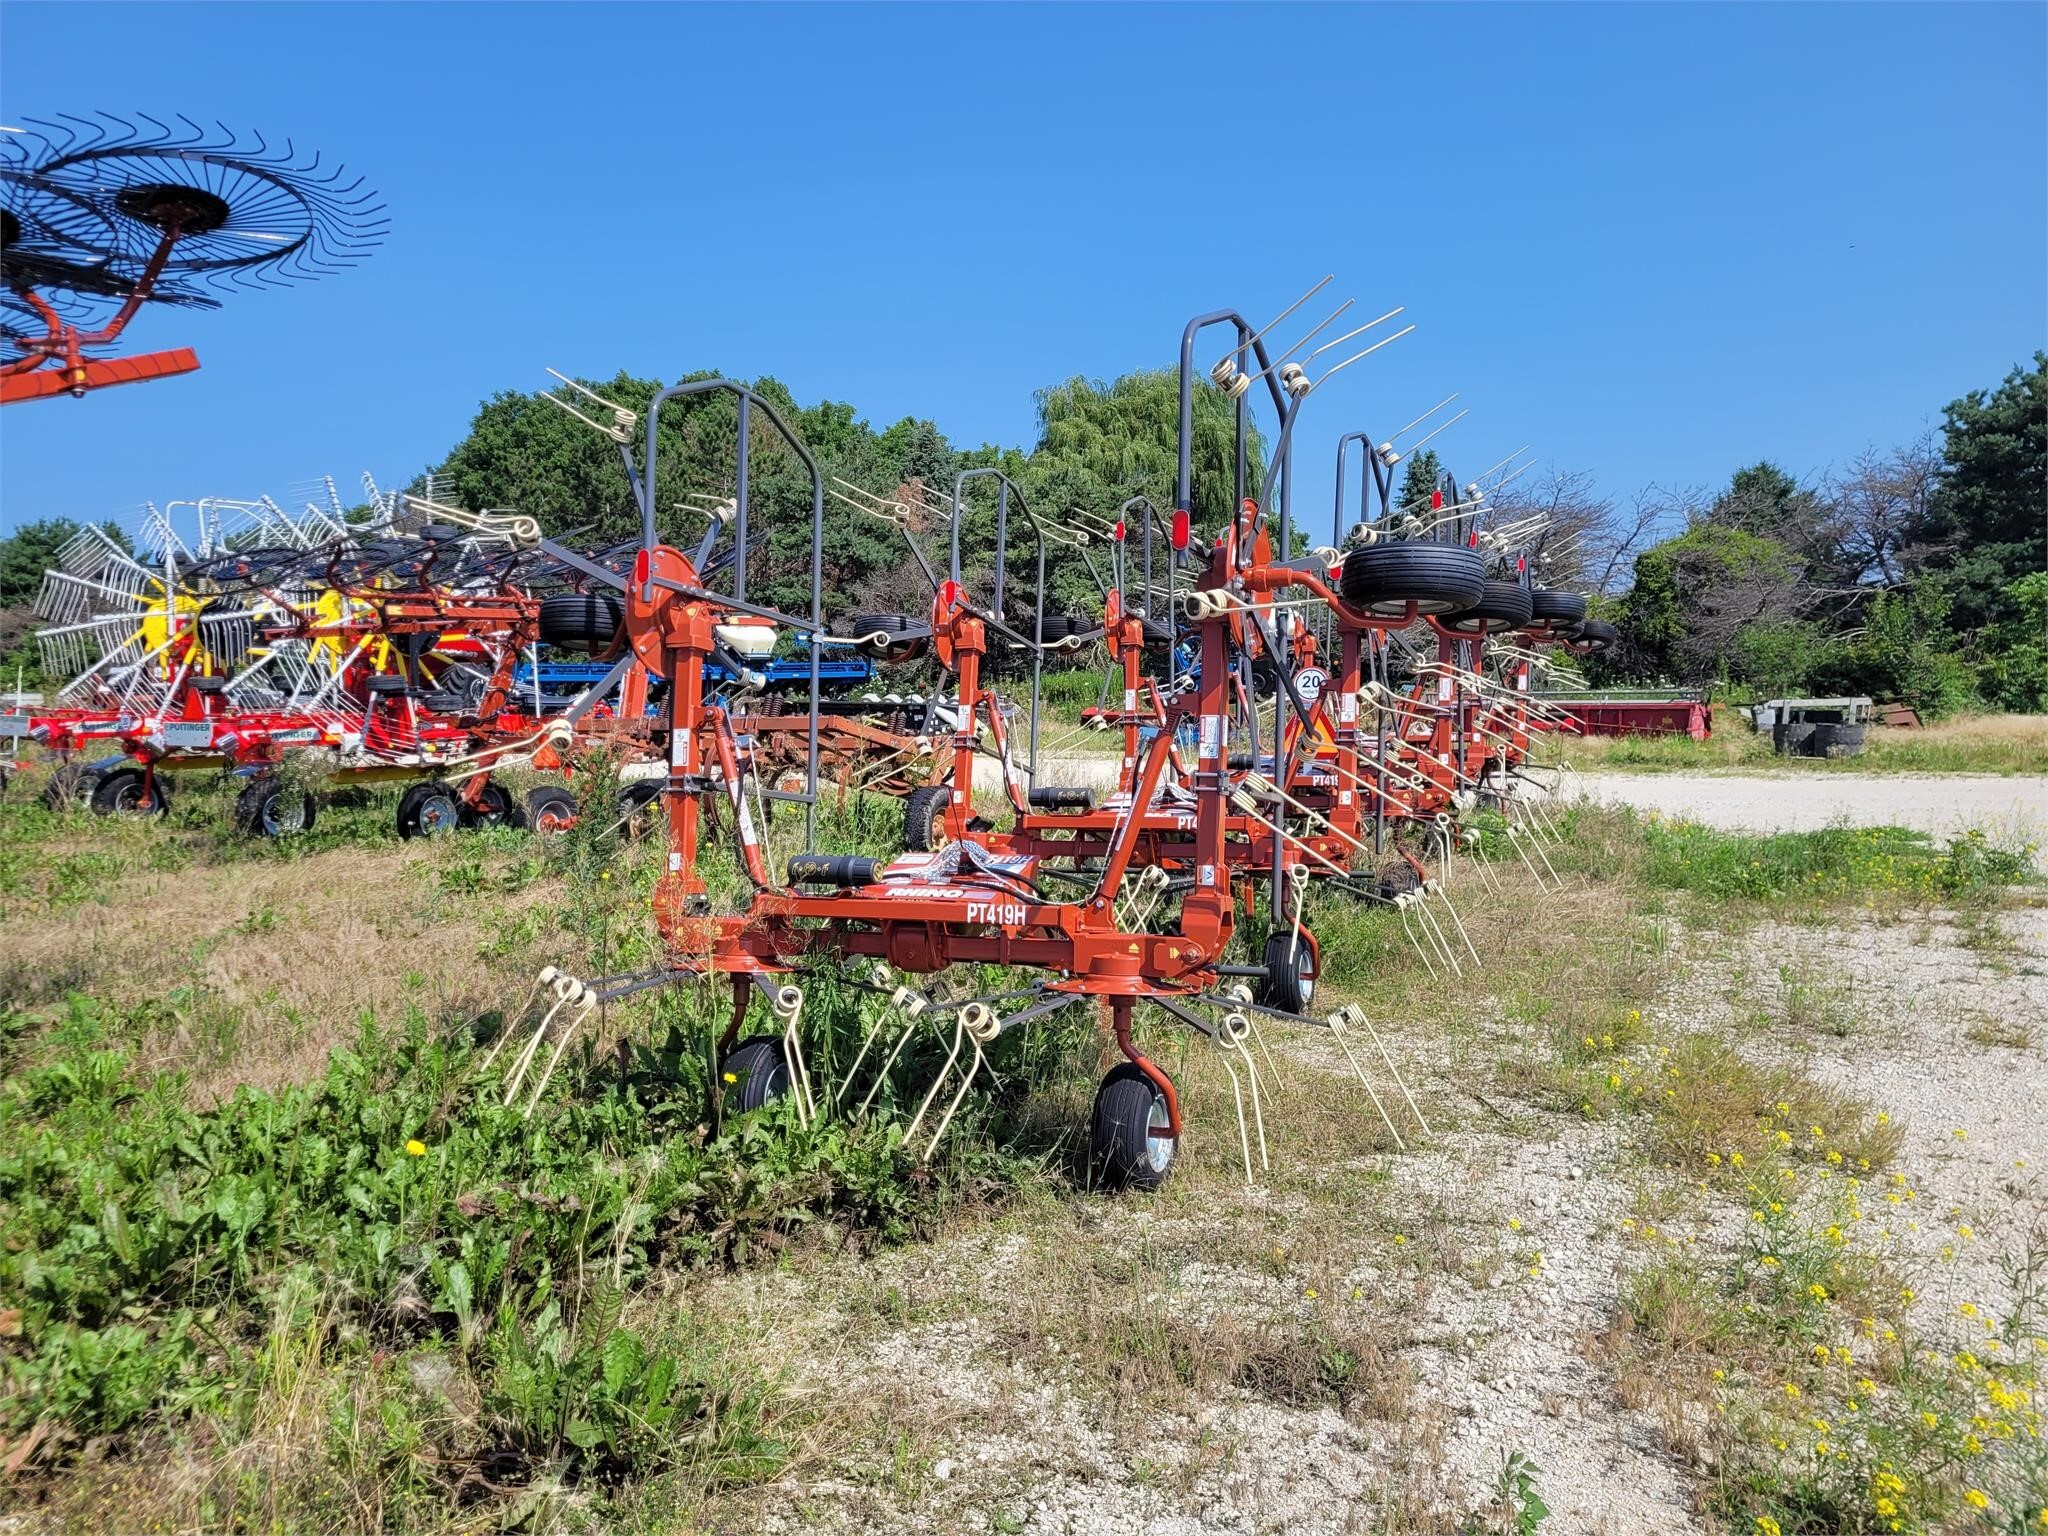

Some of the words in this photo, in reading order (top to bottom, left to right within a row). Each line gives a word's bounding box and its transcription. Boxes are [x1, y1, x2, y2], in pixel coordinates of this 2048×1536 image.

[1302, 675, 1320, 688] 20
[885, 888, 964, 898] RHINO
[967, 903, 1026, 926] PT419H
